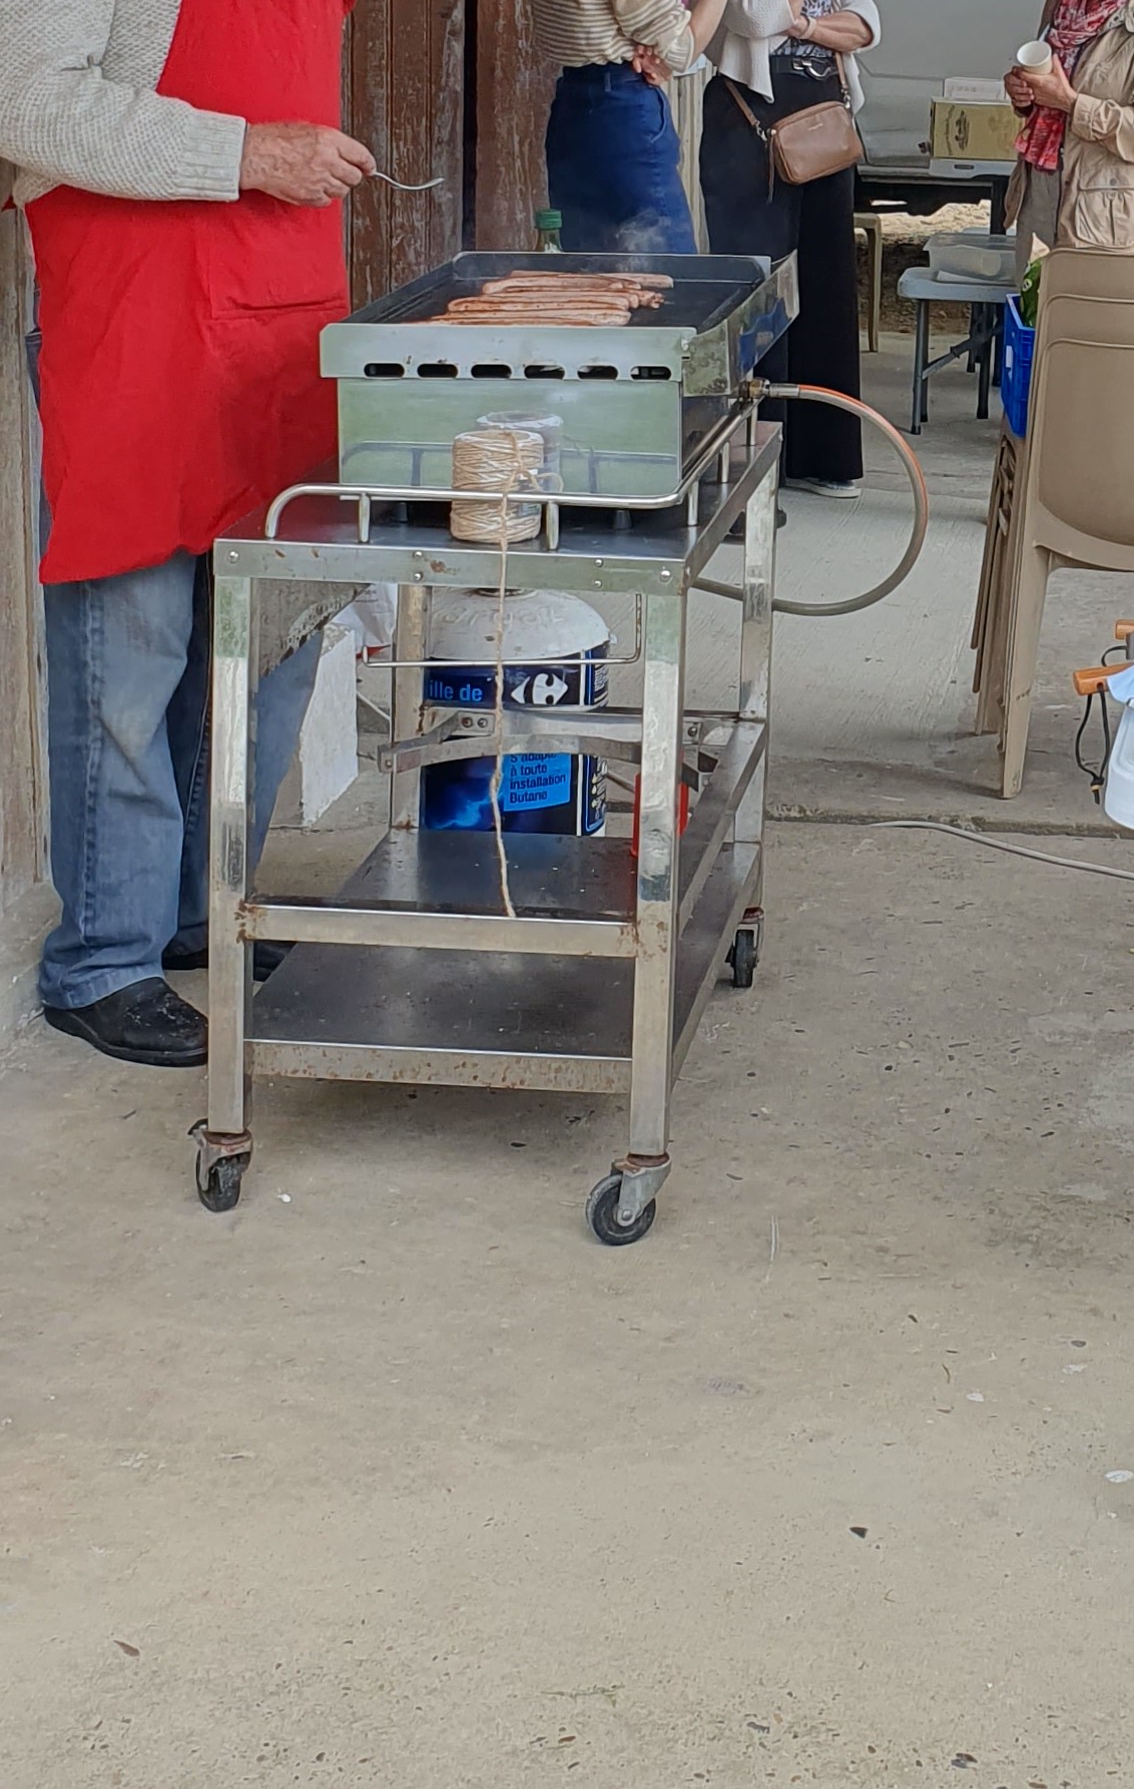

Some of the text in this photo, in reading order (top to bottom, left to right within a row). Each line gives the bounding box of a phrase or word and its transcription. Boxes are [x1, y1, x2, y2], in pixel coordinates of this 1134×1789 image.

[459, 683, 483, 702] de
[520, 763, 548, 776] toute
[509, 773, 566, 791] installation
[509, 790, 548, 804] Butane
